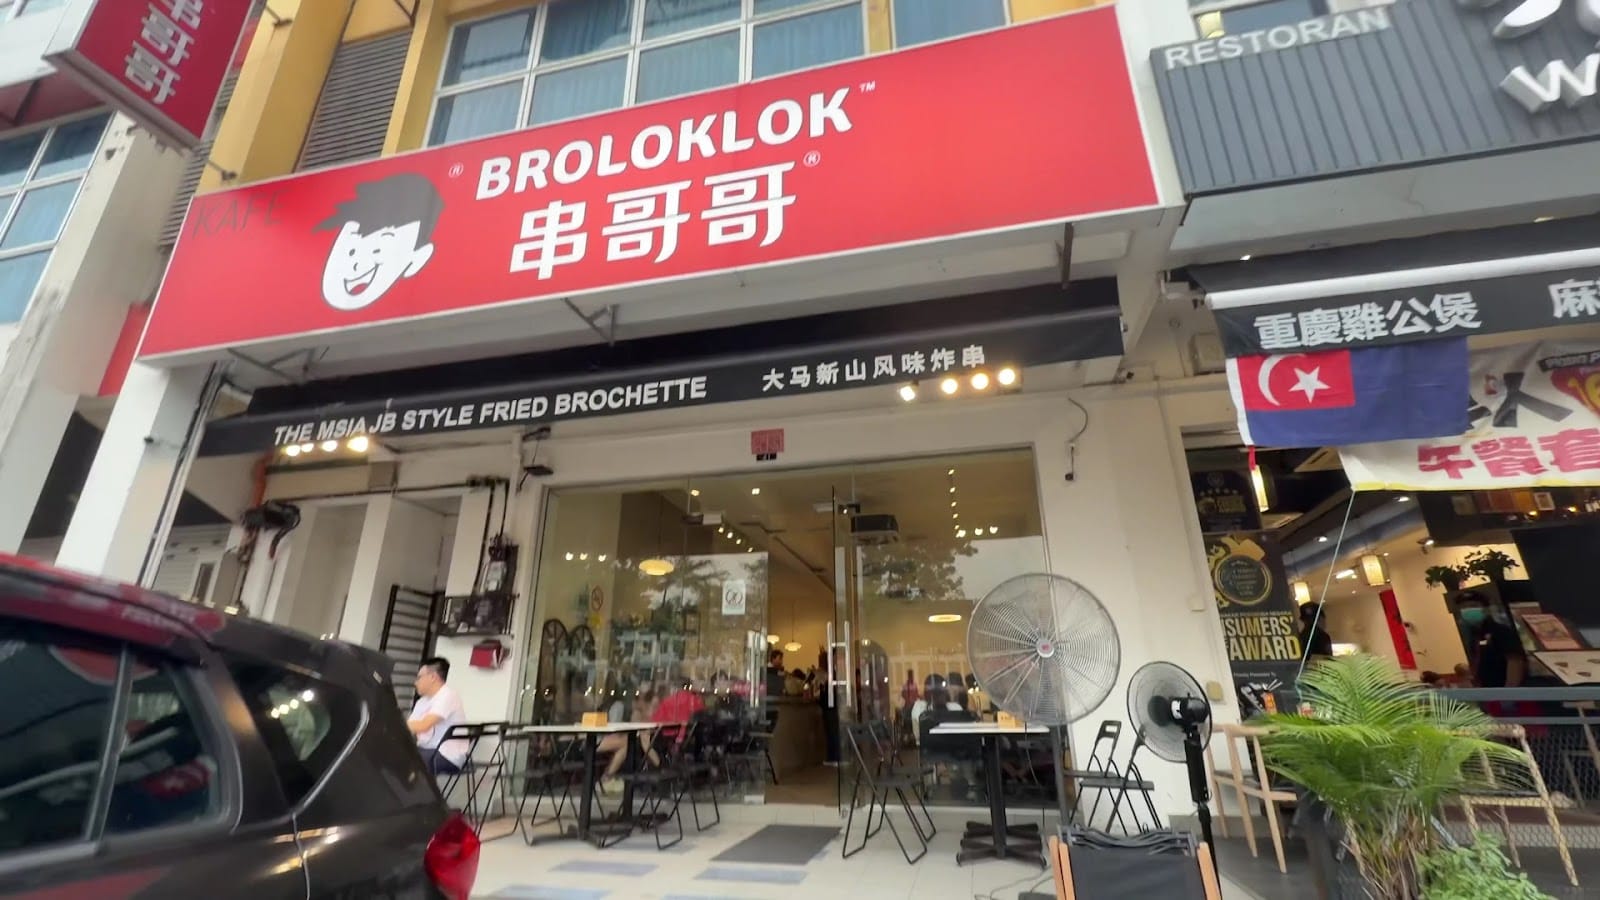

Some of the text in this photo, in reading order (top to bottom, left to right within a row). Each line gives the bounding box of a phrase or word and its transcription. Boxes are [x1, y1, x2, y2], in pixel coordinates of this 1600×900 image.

[1164, 7, 1391, 70] RESTORAN
[476, 87, 852, 200] BROLOKLOK
[192, 187, 290, 238] KAFE
[509, 161, 797, 280] 串哥哥
[1253, 277, 1600, 350] 重慶雞公煲 麻
[762, 344, 986, 392] 大马新山风味炸串
[274, 375, 708, 446] THE MSIA JB STYLE FRIED BROCHETTE
[1229, 635, 1302, 661] AWARD
